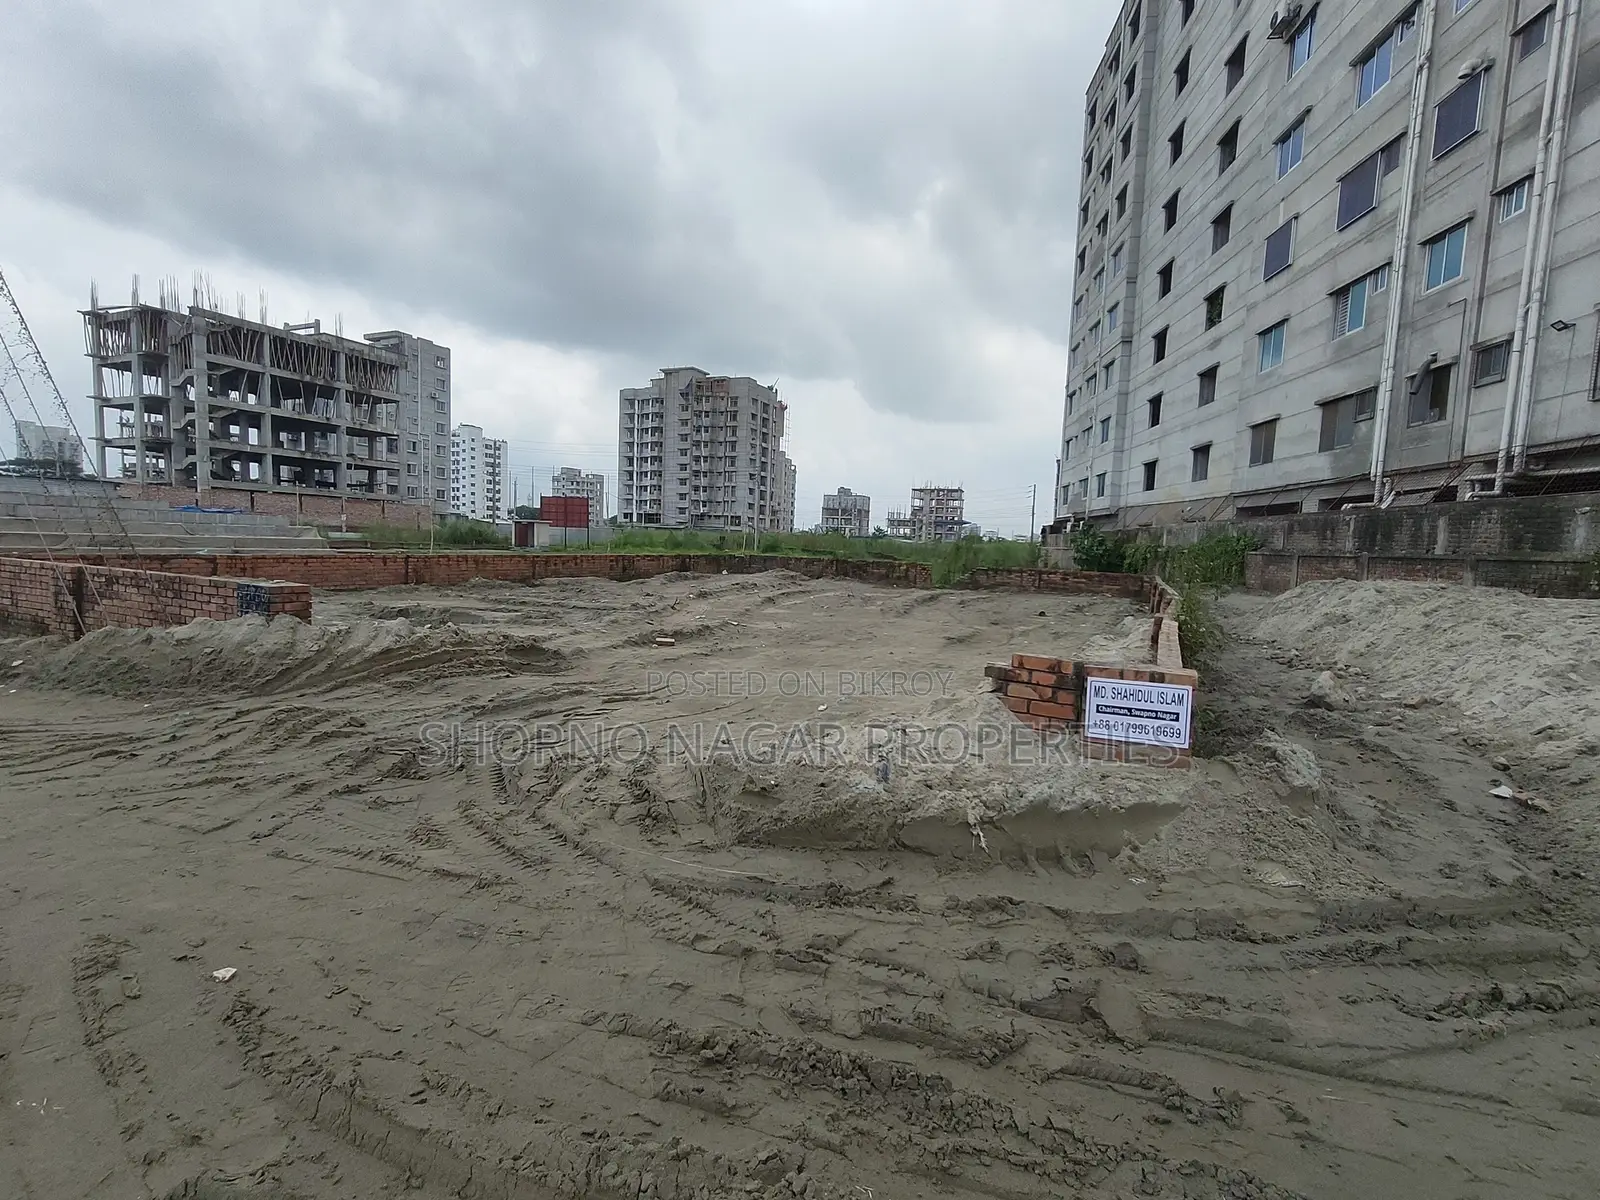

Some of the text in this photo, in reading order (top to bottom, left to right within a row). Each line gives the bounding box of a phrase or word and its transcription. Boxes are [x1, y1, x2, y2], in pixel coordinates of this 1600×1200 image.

[1093, 685, 1185, 707] MD. SHAHIDUL ISLAM
[1098, 705, 1178, 720] Chairman, Swapno Nagar
[1093, 719, 1110, 731] +88
